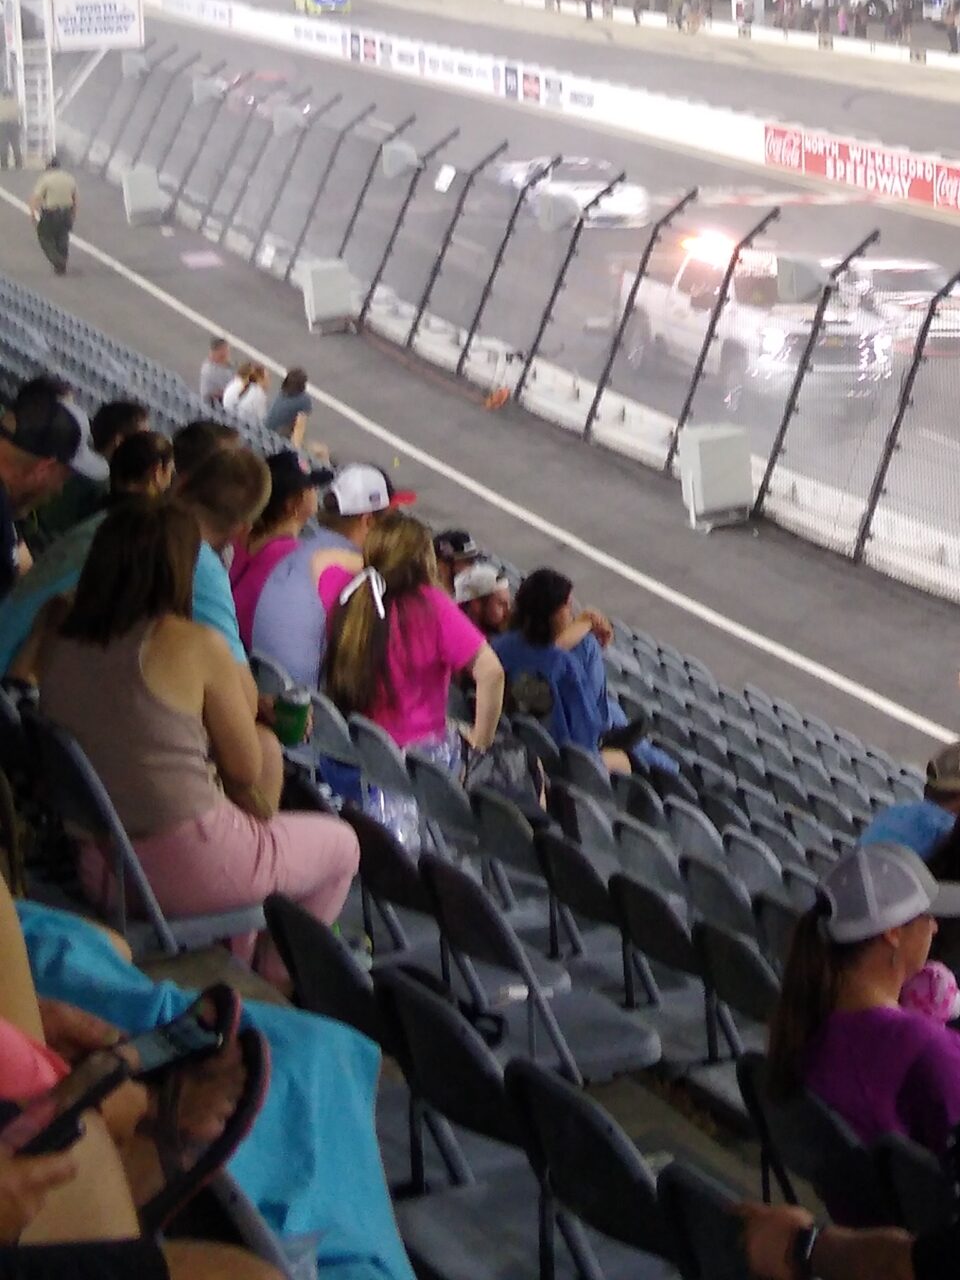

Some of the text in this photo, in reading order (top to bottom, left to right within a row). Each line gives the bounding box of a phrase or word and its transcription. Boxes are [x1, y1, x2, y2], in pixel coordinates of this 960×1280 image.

[805, 136, 934, 183] NORTH WILKESBORO
[825, 157, 913, 199] SPEEDWAY
